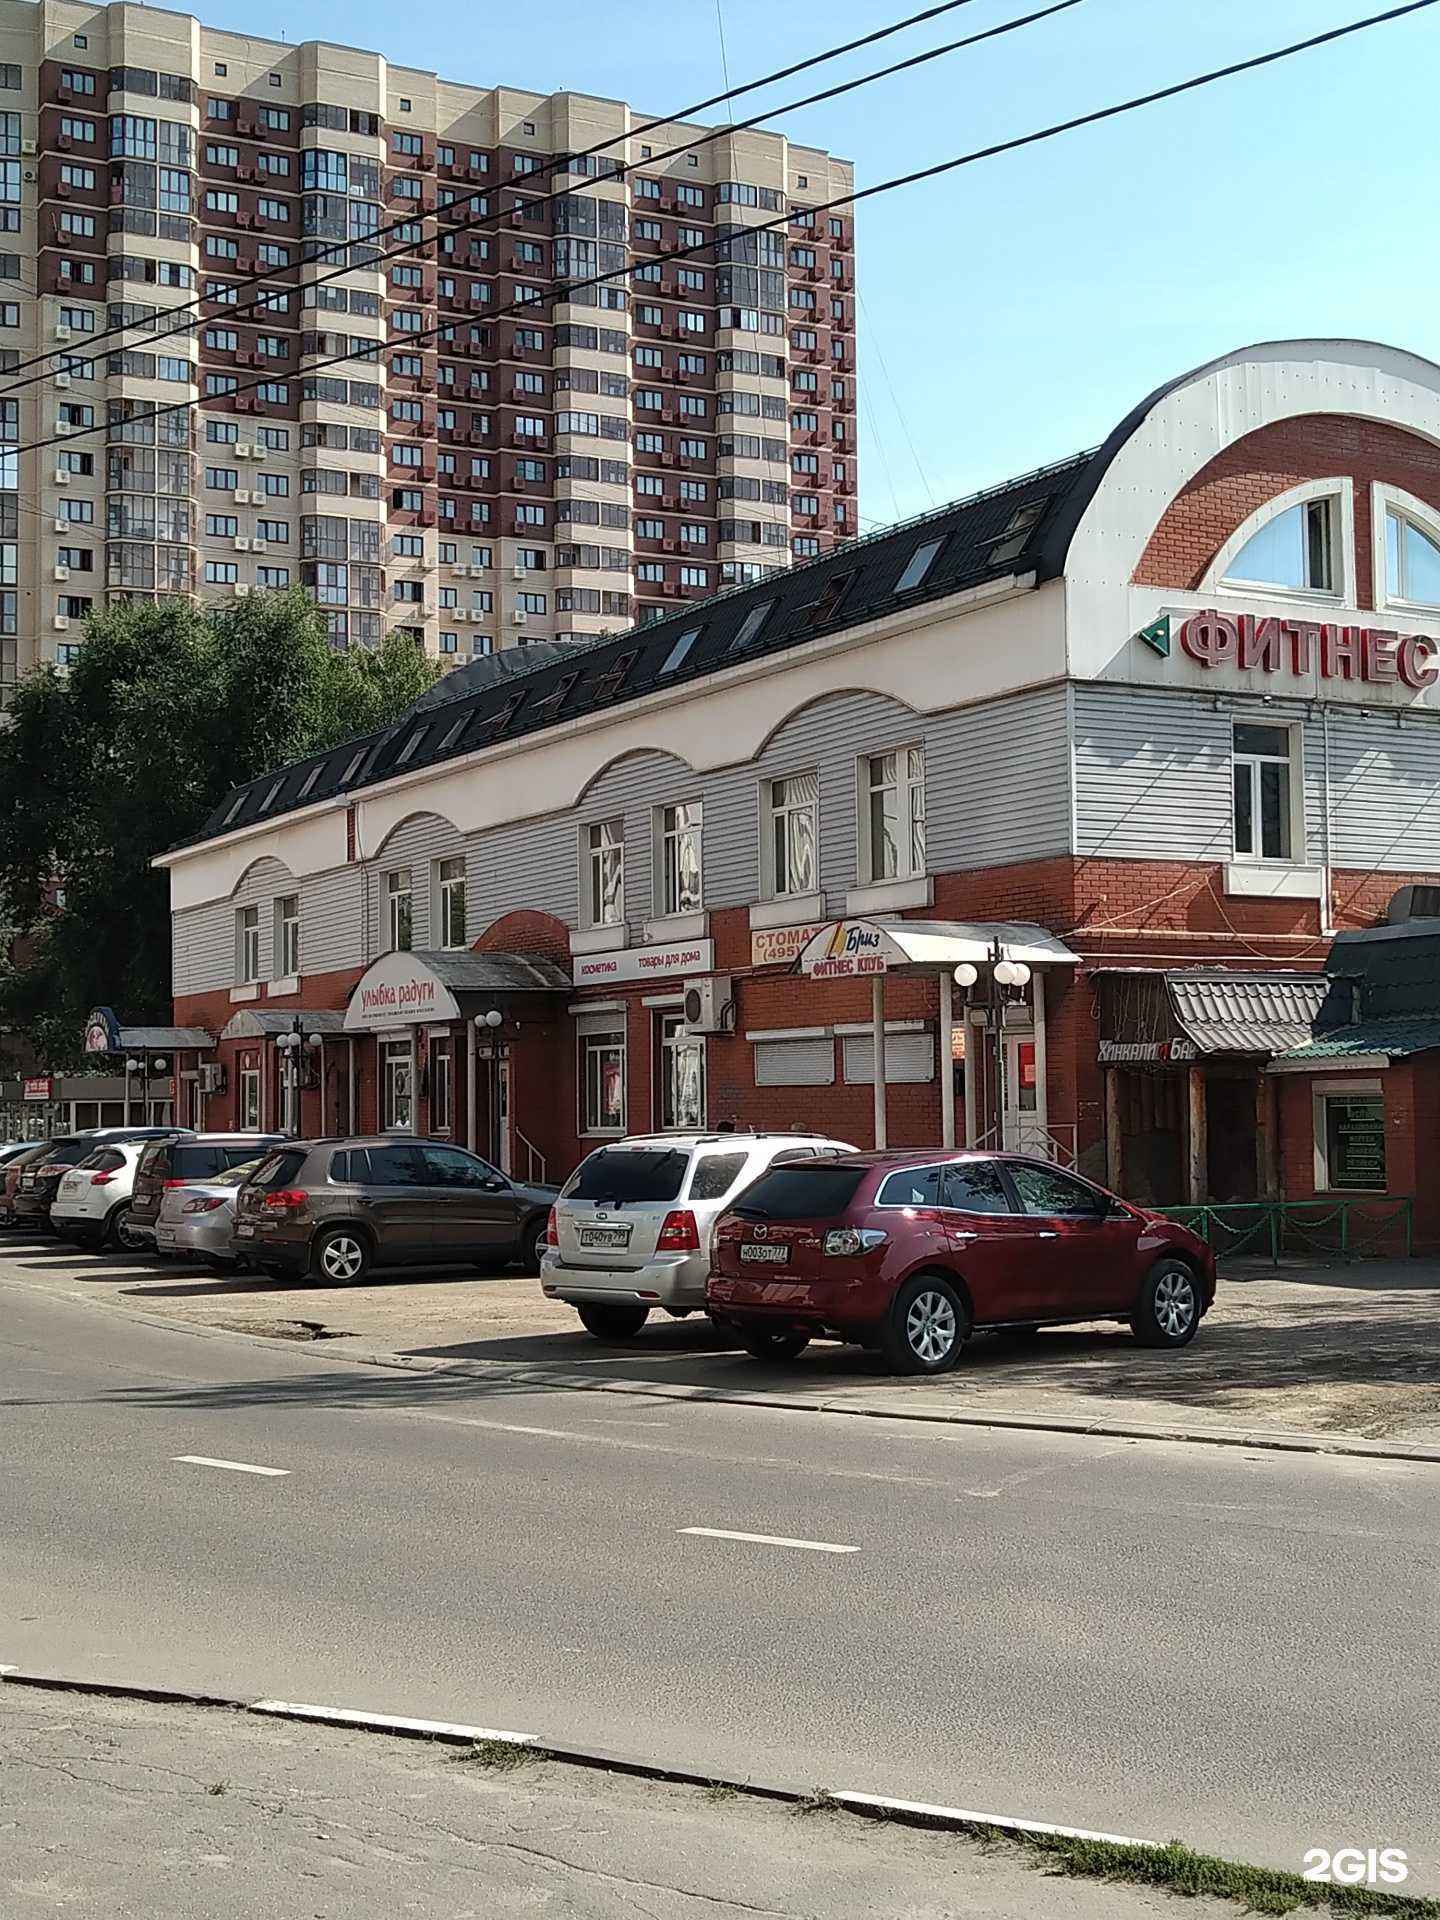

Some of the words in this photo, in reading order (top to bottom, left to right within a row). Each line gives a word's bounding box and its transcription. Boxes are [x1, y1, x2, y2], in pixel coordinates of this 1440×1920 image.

[1180, 608, 1439, 689] ФИТНЕС
[846, 926, 881, 953] Бриз
[638, 954, 664, 969] товары
[665, 954, 679, 968] для
[680, 950, 701, 966] дома
[763, 945, 801, 962] (495)
[813, 958, 854, 976] ФИТНЕС
[857, 955, 884, 973] КЛУБ
[361, 983, 395, 1011] улыбка
[398, 979, 434, 1009] радуги
